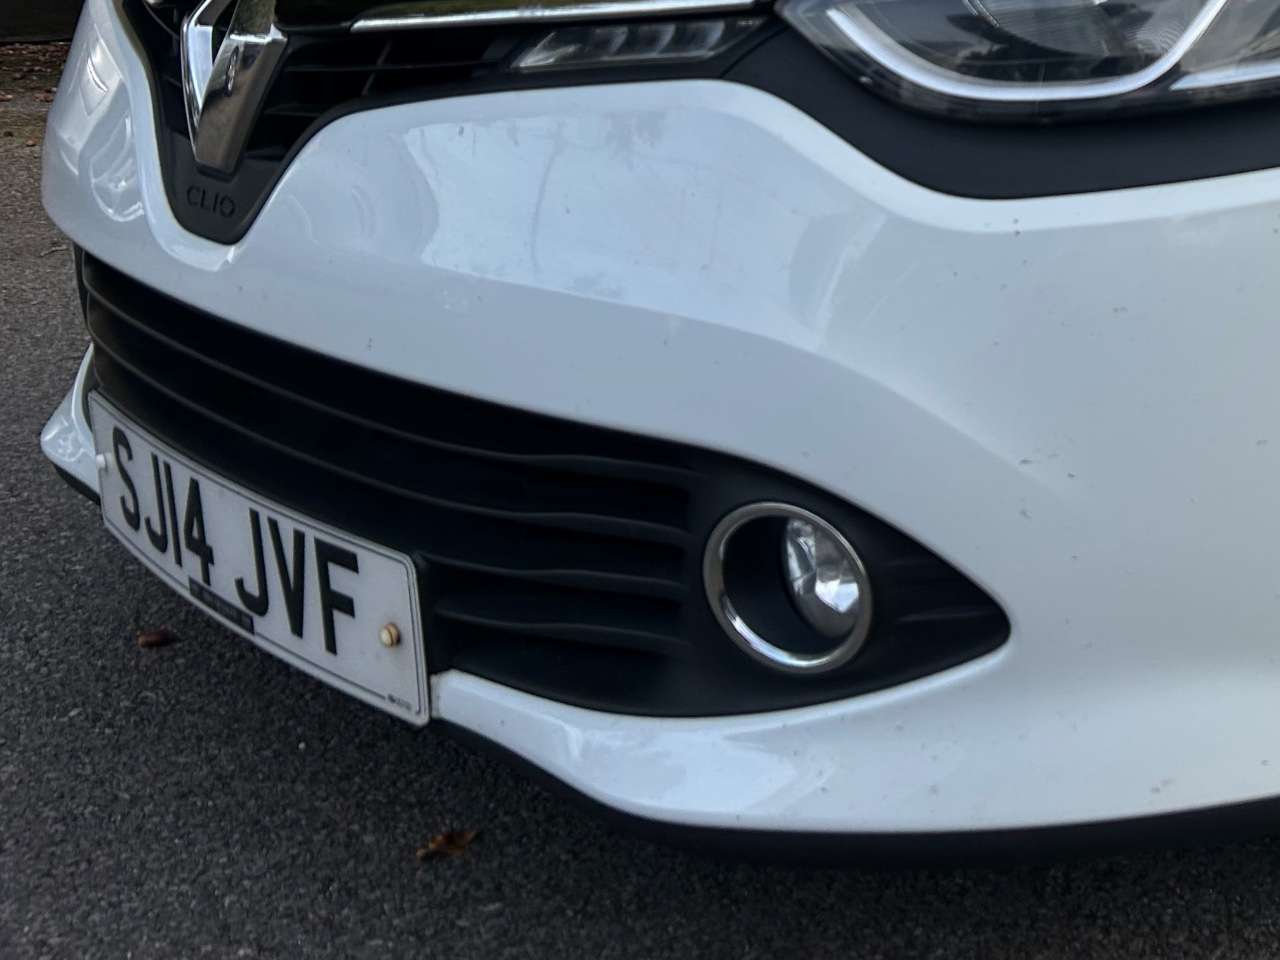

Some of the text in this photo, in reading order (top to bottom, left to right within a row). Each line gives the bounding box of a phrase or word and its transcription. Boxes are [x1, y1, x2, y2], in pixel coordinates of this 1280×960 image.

[186, 184, 236, 218] CLIO
[112, 425, 360, 657] SJ14 JVF
